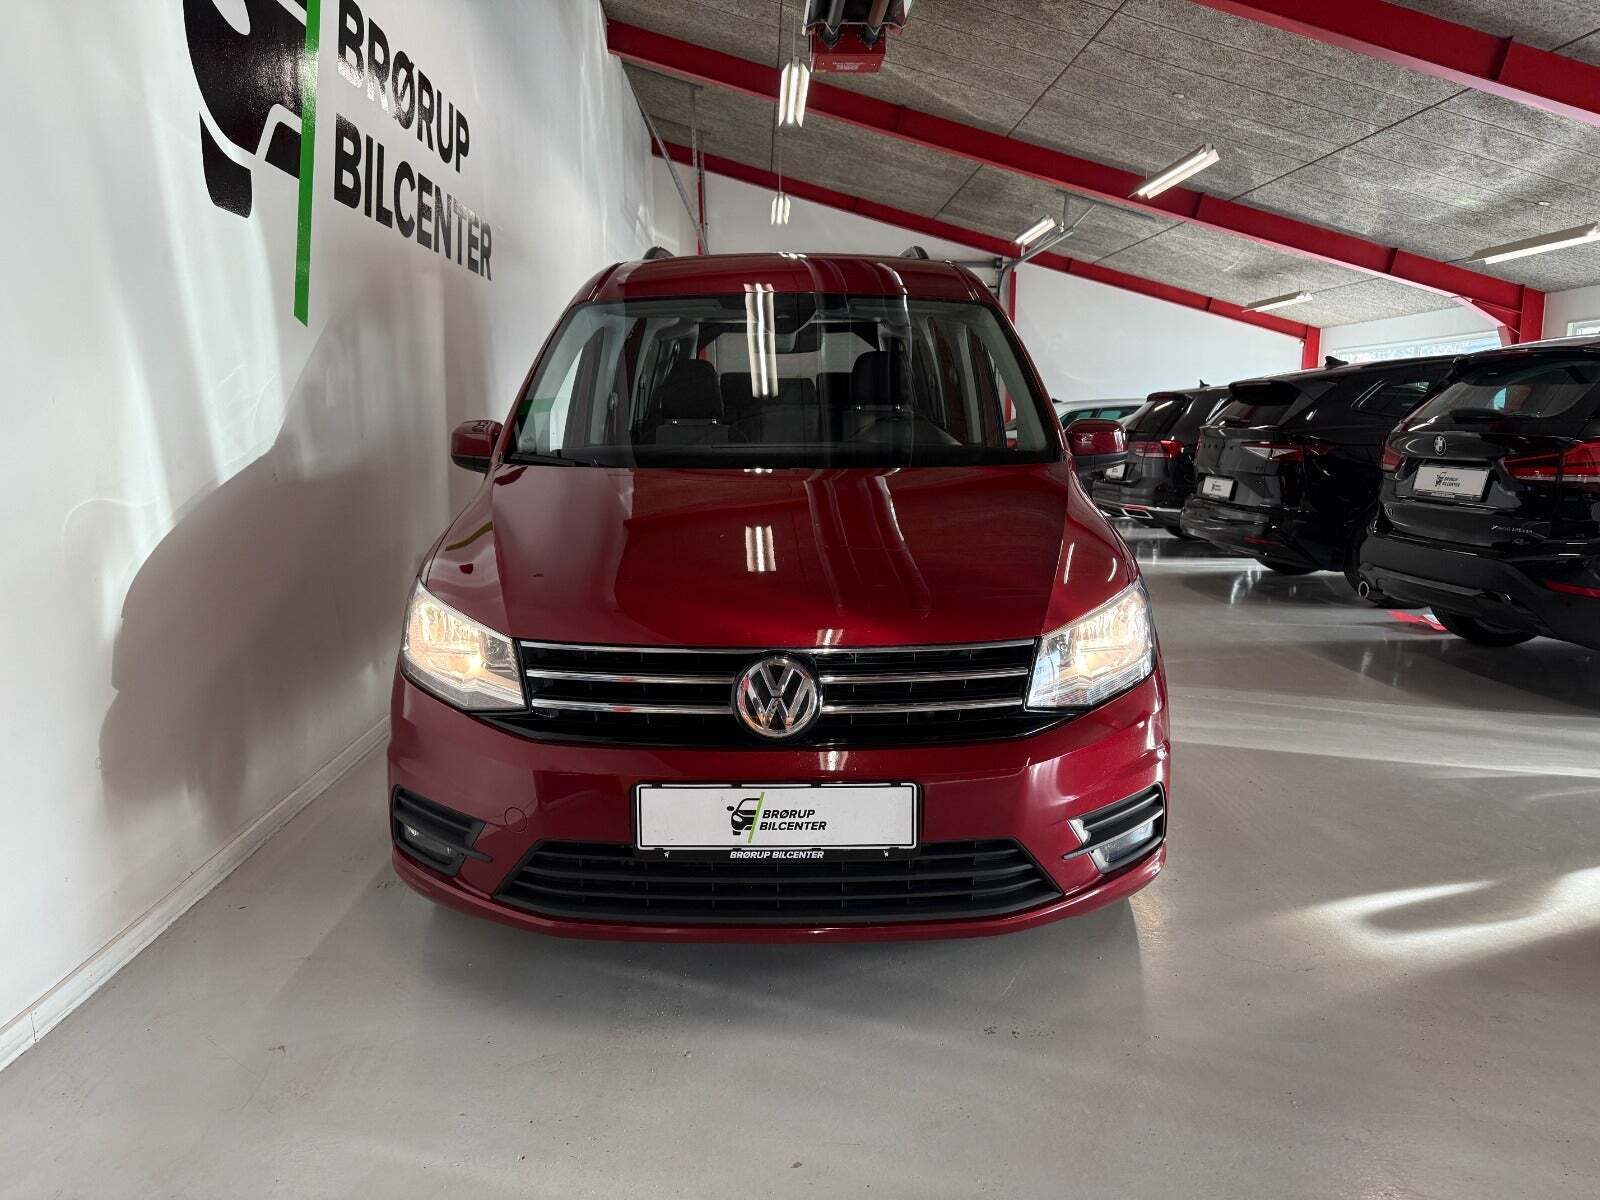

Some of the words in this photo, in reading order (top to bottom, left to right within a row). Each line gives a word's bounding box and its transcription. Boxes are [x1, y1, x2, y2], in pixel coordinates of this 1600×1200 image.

[337, 0, 470, 173] BRØRUP
[334, 112, 493, 281] BILCENTER
[762, 809, 815, 819] BRØRUP
[759, 821, 827, 831] BILCENTER
[729, 851, 770, 859] BRØRUP
[772, 851, 824, 859] BILCENTER
